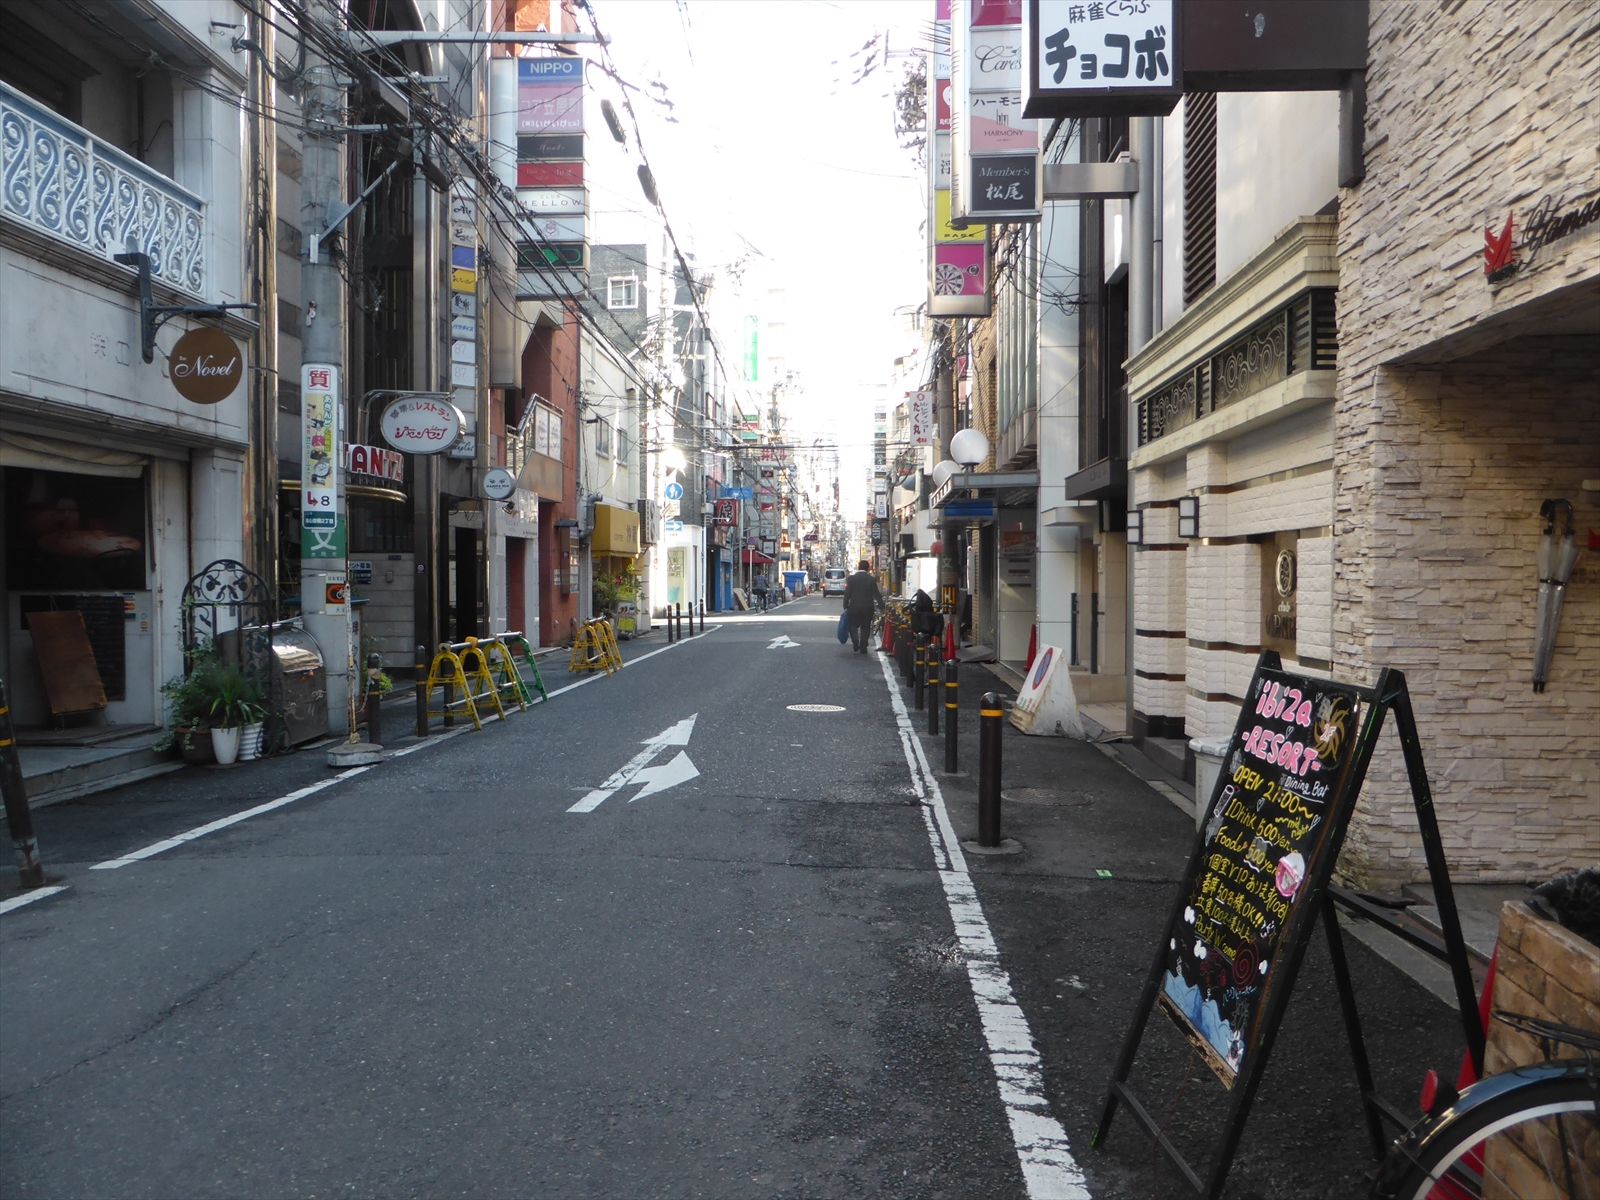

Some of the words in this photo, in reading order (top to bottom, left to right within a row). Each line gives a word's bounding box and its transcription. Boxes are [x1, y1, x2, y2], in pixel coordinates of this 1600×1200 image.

[1044, 25, 1169, 84] チョコボ
[530, 62, 572, 74] NIPPO
[984, 129, 1024, 137] HARMONY
[978, 167, 1031, 177] Member's
[985, 182, 1024, 201] 松尾
[174, 355, 236, 377] Novel
[309, 371, 328, 387] 質
[321, 496, 330, 506] 8
[1233, 765, 1264, 791] OPEN
[1284, 775, 1311, 795] Dining
[1312, 780, 1329, 797] Bar
